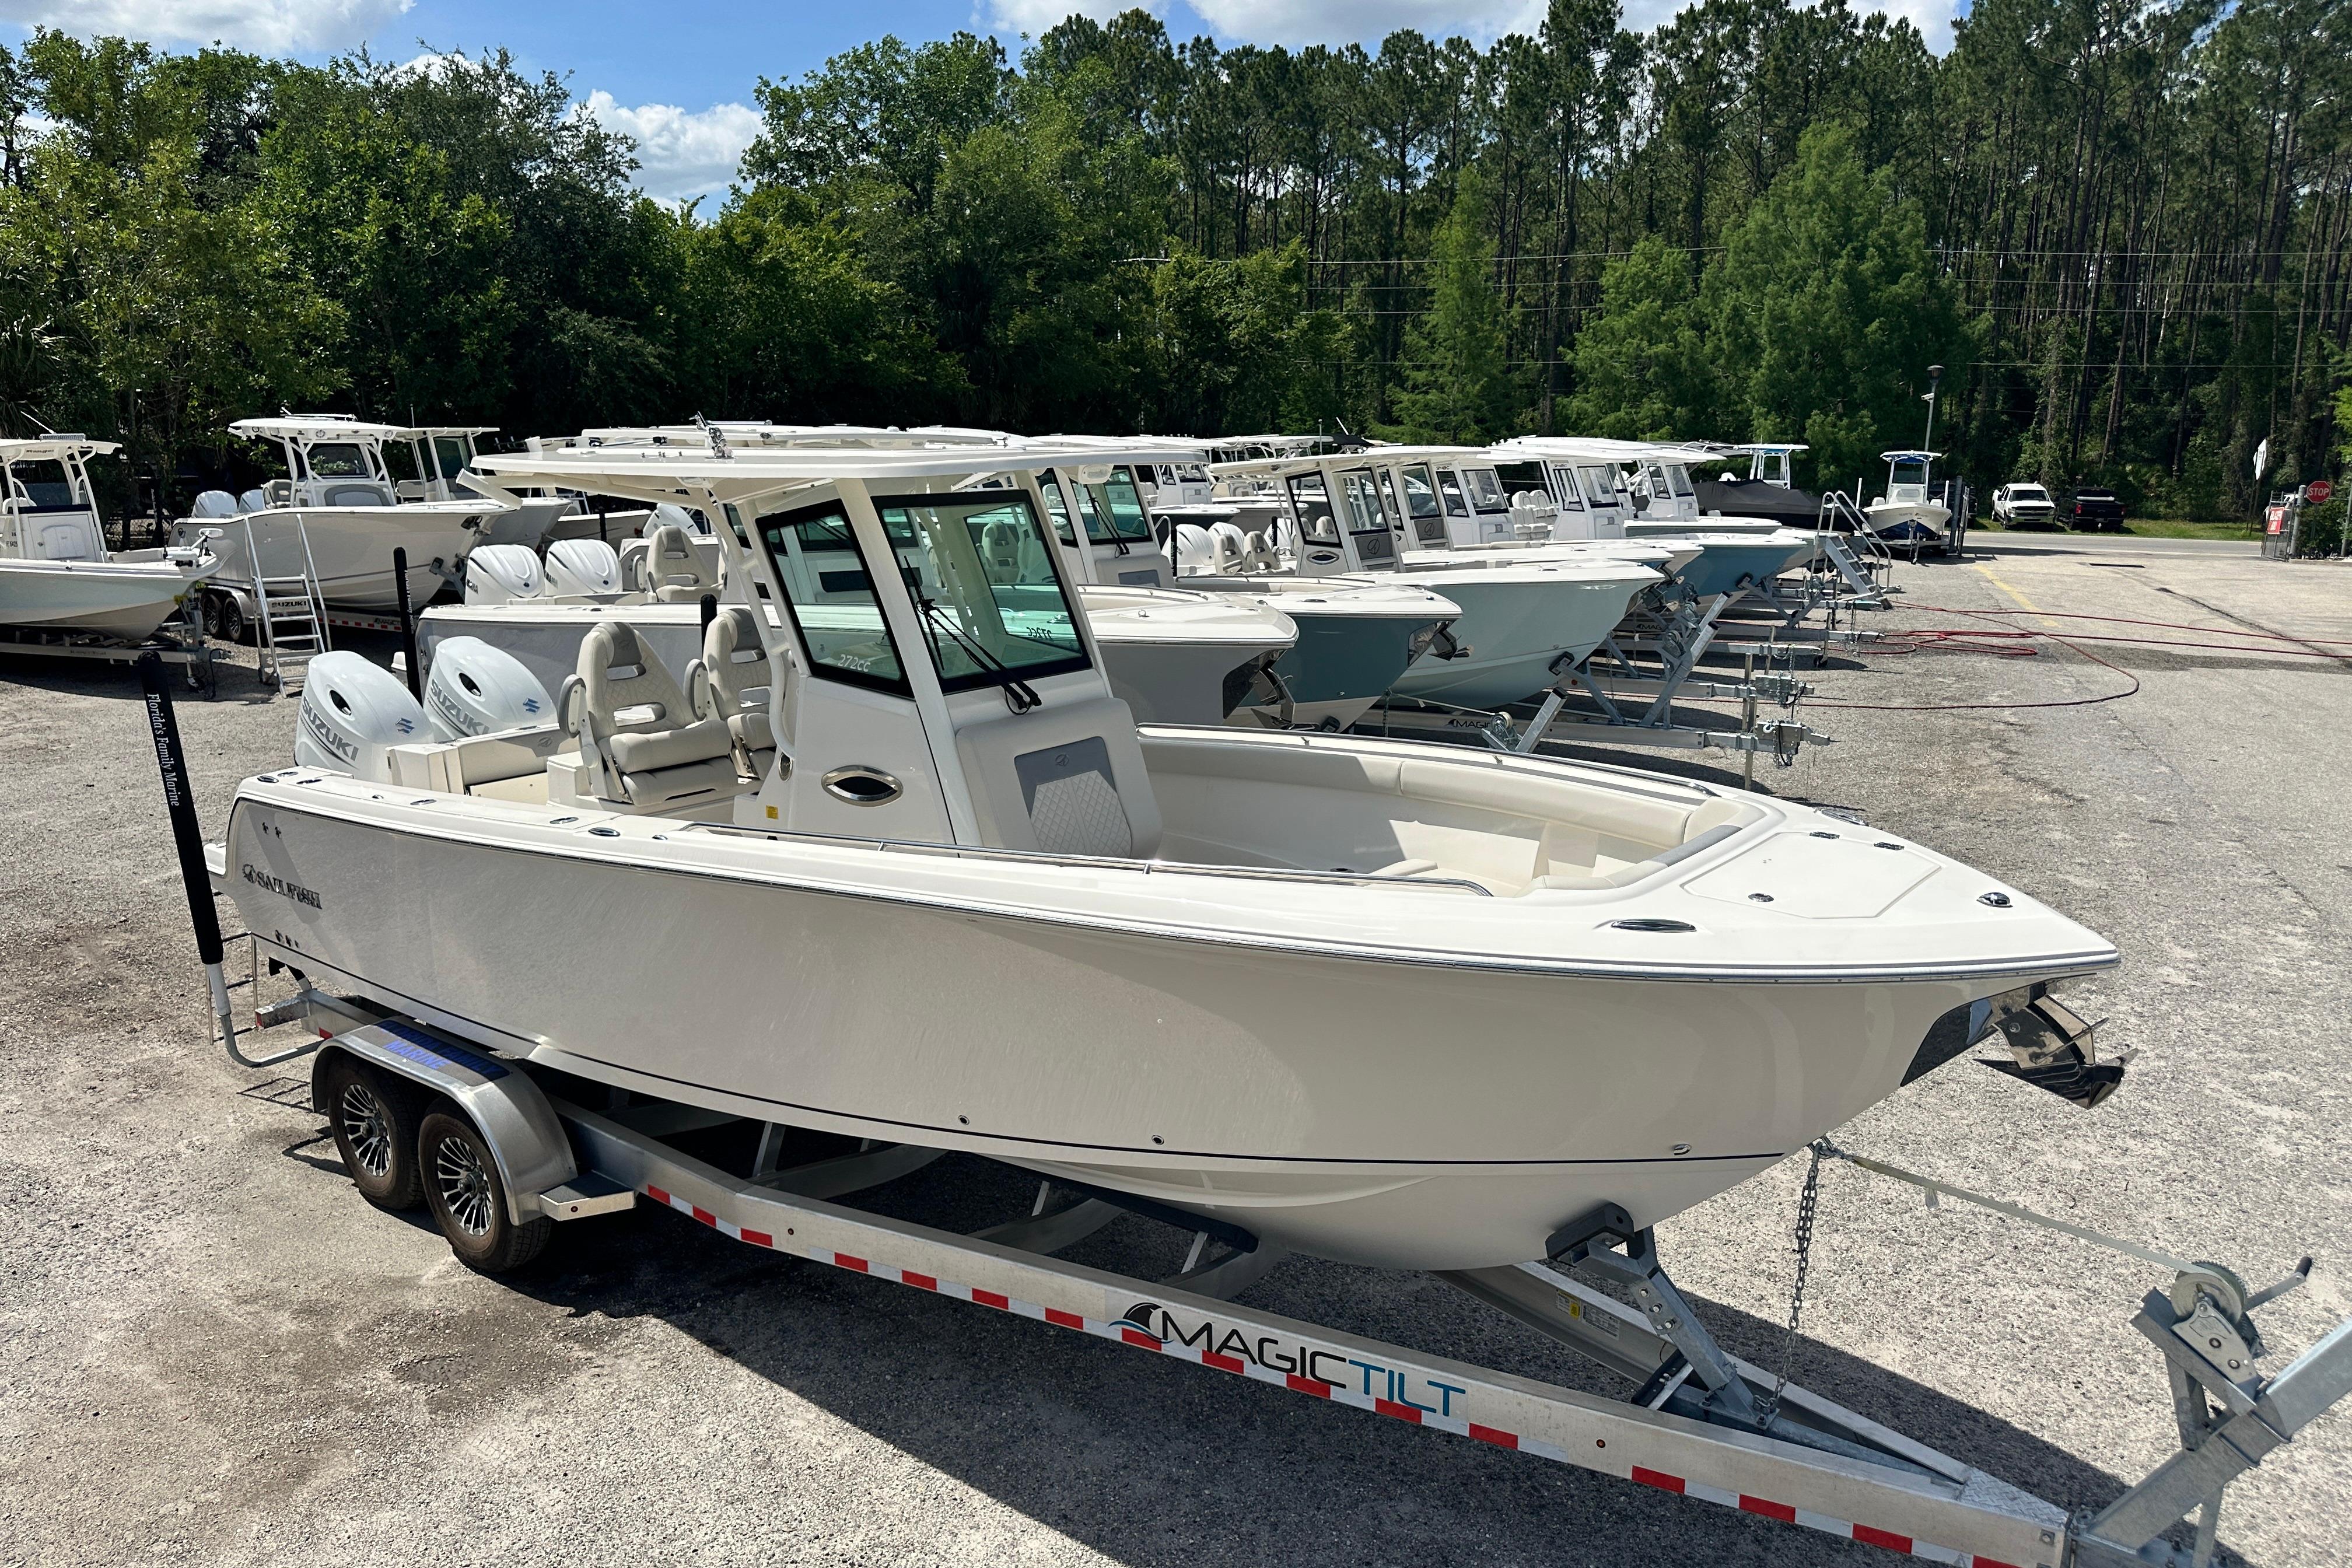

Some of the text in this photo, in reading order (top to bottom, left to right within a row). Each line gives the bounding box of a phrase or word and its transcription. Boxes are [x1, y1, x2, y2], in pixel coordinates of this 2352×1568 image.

[2308, 487, 2329, 496] STOP
[271, 600, 307, 608] SUZUKI
[302, 695, 360, 762] SUZUKI
[430, 678, 491, 735] SUZUKI
[146, 693, 181, 807] Florida's Family Marine
[257, 871, 323, 909] SAILFISH
[383, 1040, 452, 1070] MARINE
[1161, 1309, 1466, 1417] MAGICTILT
